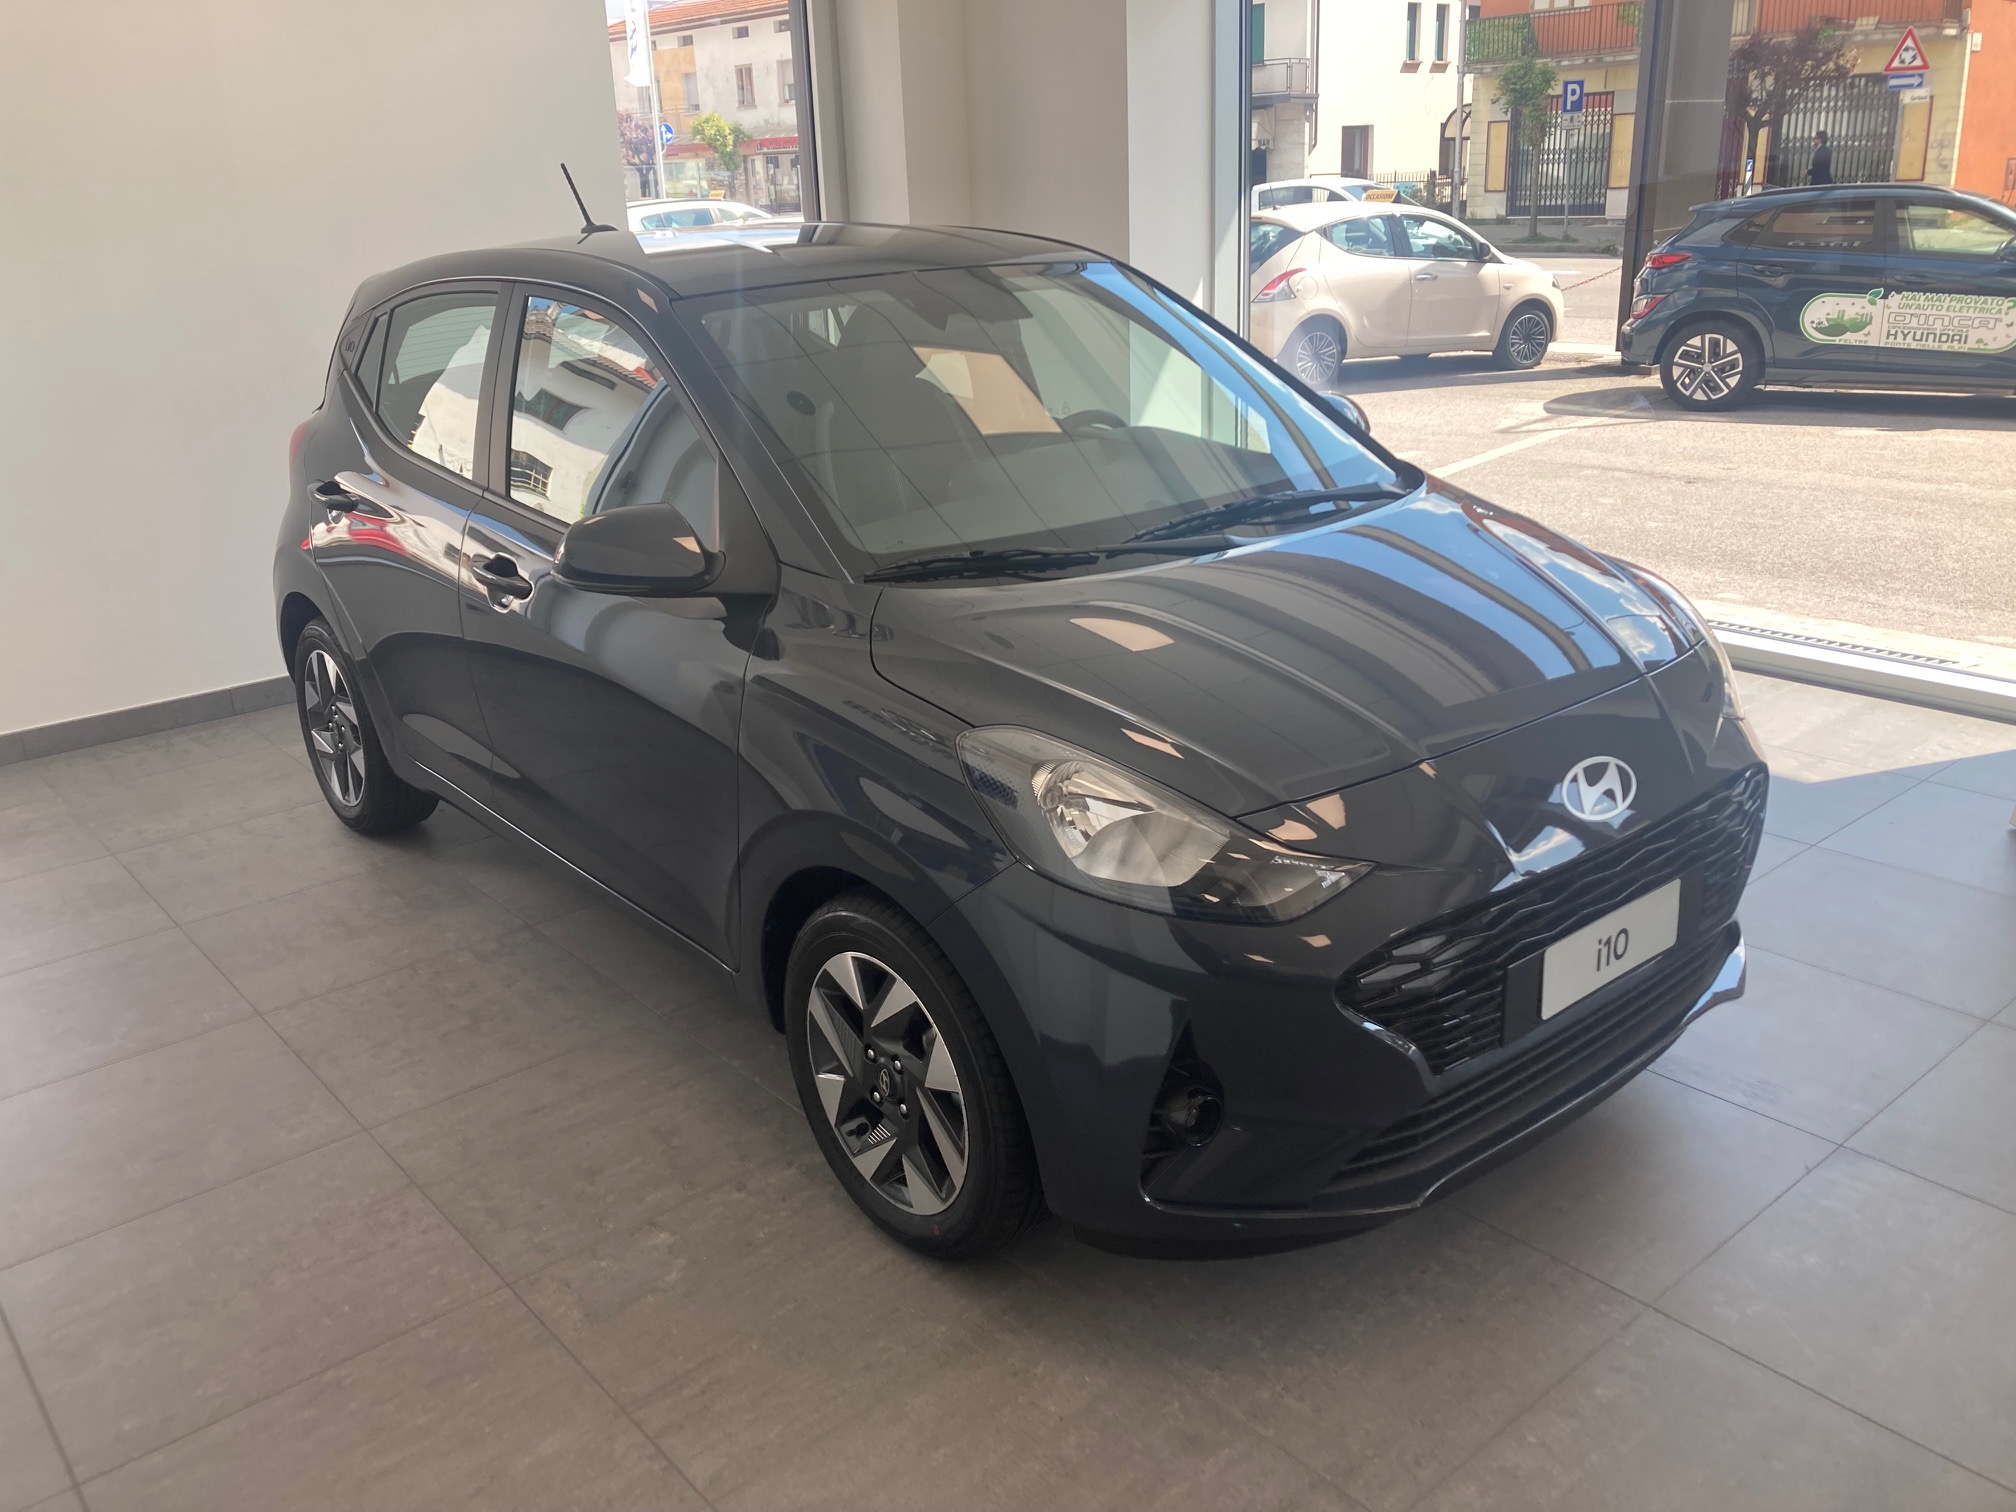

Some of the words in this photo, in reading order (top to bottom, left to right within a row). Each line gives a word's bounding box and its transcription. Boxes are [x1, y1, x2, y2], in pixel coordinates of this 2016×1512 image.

[1567, 83, 1580, 110] P
[1900, 293, 1921, 302] HAI
[1923, 294, 1946, 303] MAI
[1949, 295, 2005, 306] PROVATO
[1898, 302, 1943, 312] UN'AUTO
[1946, 305, 2003, 315] ELETTRICA
[1886, 330, 1969, 344] HYUNDAI
[1597, 928, 1629, 971] i10
